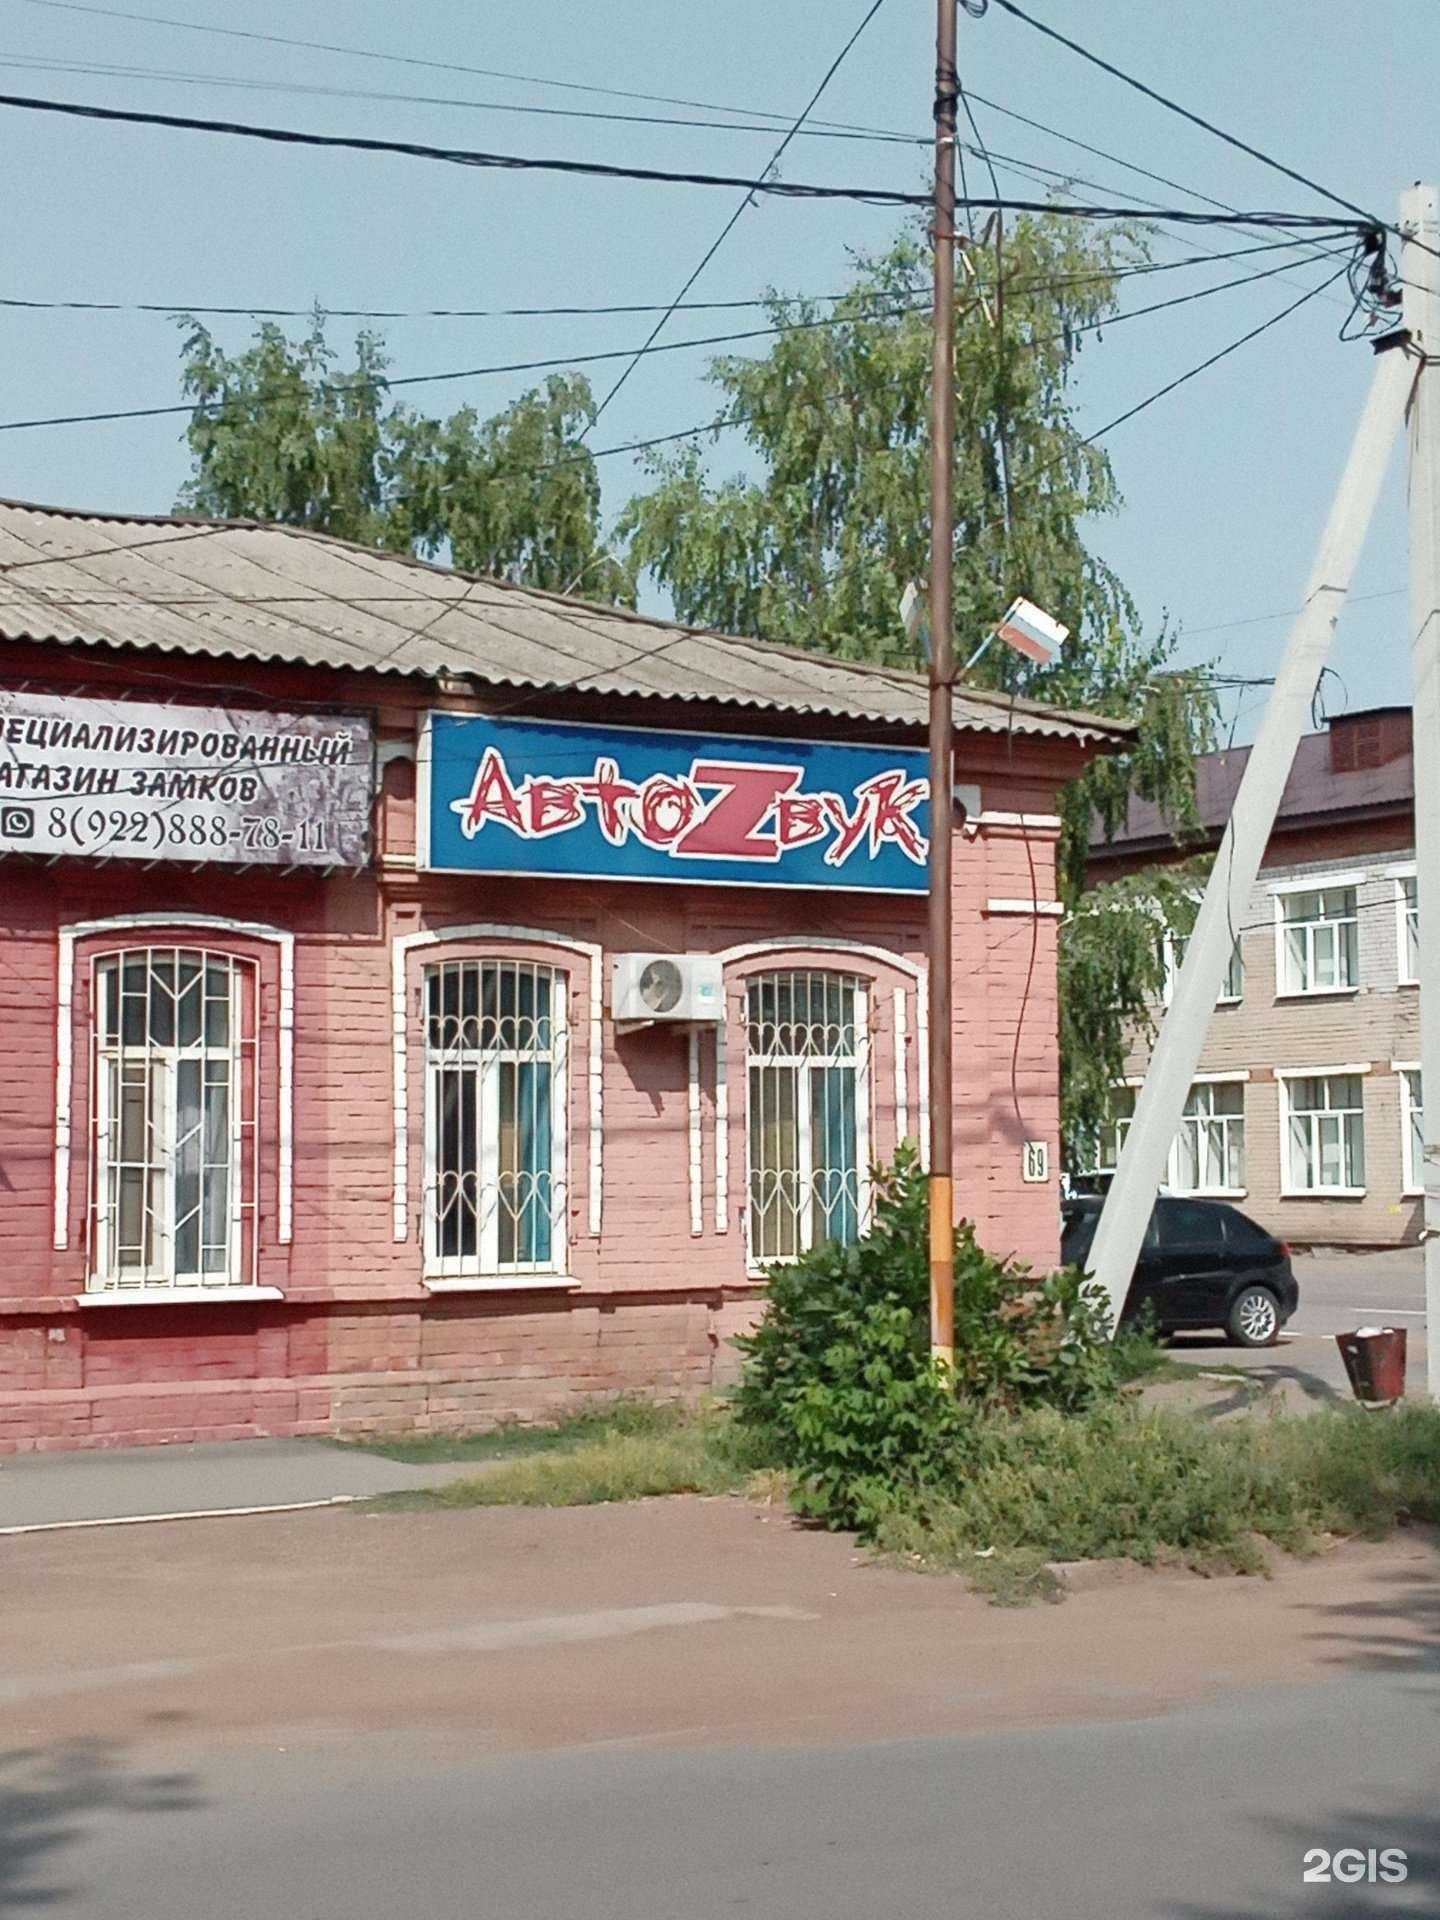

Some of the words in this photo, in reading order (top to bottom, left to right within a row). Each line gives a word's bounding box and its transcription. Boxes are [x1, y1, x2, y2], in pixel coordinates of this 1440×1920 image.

[0, 716, 352, 766] ЕЦИАЛИЗИРОВАННЫЙ
[131, 769, 258, 802] ЗАМКОВ
[48, 806, 325, 850] 8(922)888-78-11
[1029, 1148, 1044, 1176] 69
